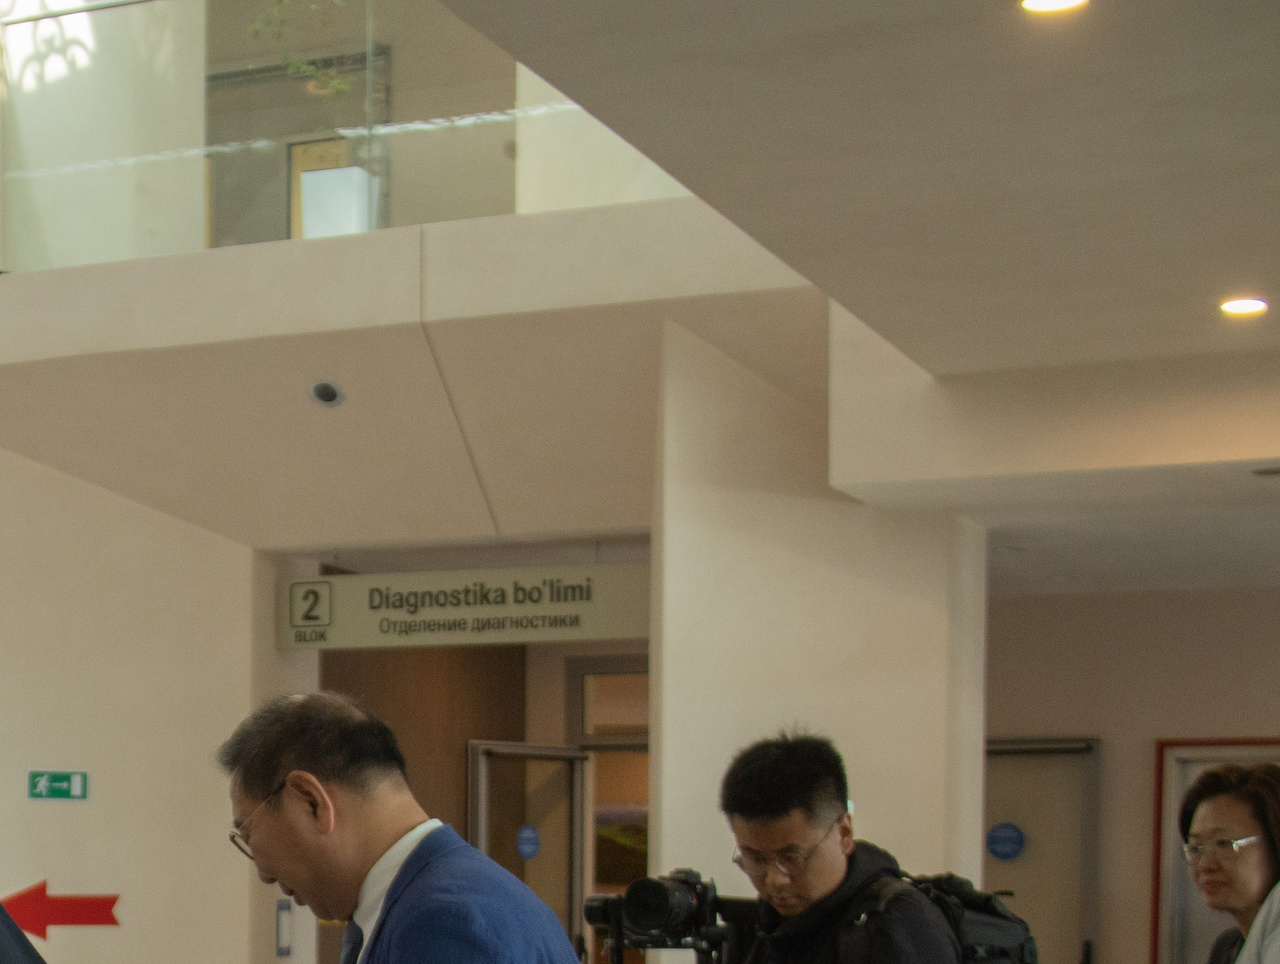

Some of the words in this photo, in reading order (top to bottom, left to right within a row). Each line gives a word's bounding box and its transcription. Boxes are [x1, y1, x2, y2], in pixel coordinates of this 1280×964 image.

[301, 589, 320, 620] 2
[368, 582, 506, 614] Diagnostika
[379, 615, 468, 636] Отделение
[471, 612, 581, 634] диагностики
